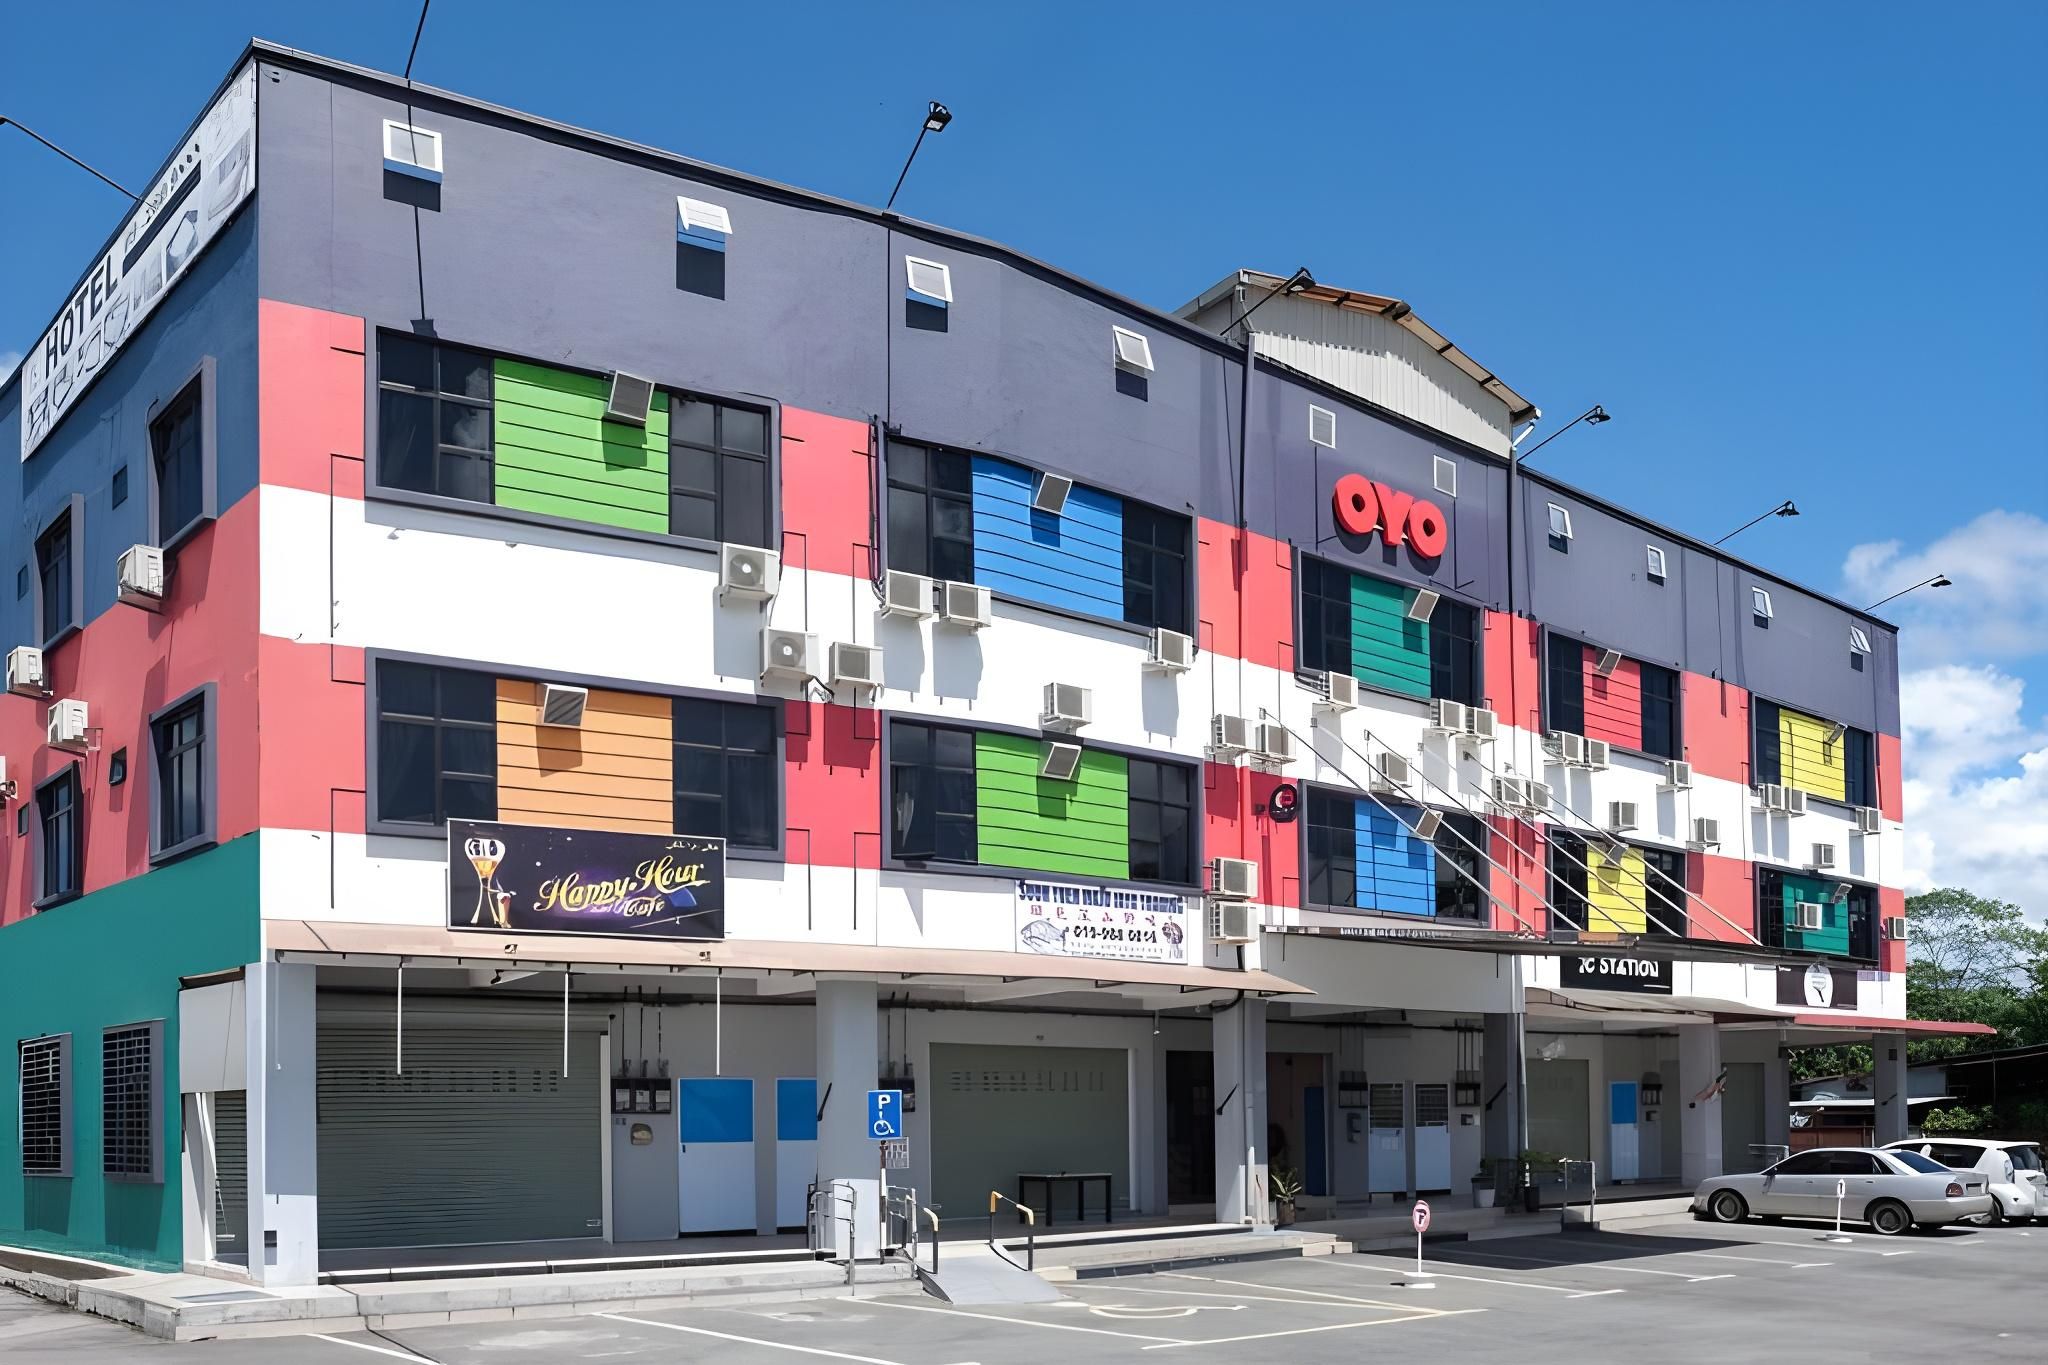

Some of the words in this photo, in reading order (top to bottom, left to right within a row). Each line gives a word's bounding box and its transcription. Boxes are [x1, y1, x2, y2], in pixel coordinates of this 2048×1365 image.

[46, 254, 118, 380] HOTEL
[1333, 473, 1447, 559] OYO
[533, 872, 630, 912] Happy
[635, 855, 711, 894] Hour
[1600, 957, 1659, 977] STATION
[878, 1094, 891, 1109] P
